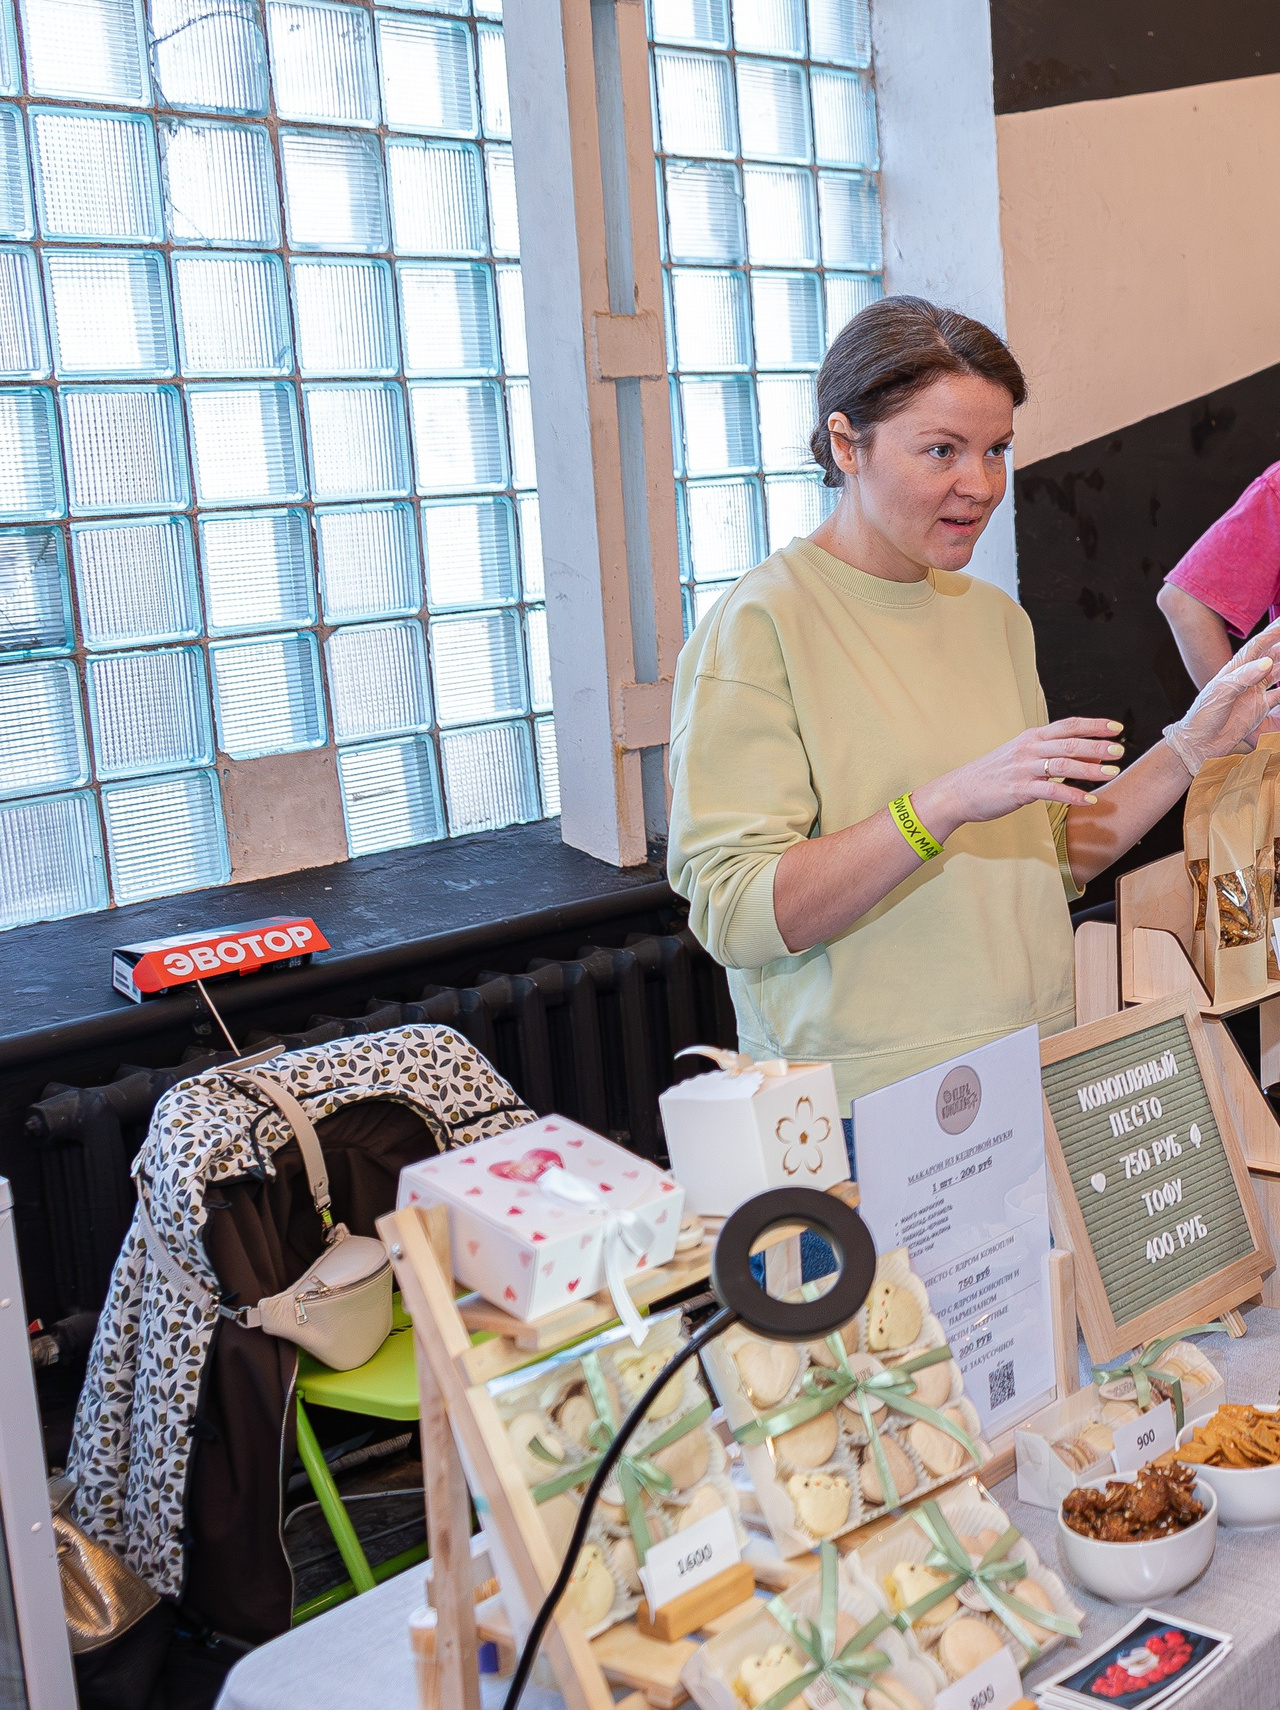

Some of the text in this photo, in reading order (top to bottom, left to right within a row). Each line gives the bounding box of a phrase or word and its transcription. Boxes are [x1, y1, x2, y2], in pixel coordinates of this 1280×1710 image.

[163, 926, 313, 976] ЭВОТОР
[1077, 1049, 1179, 1112] КОНОПЛЯНЫЙ
[1108, 1096, 1163, 1138] ПЕСТО
[945, 1157, 955, 1168] ИЗ
[955, 1137, 992, 1164] КЕДРОВОЙ
[992, 1128, 1014, 1146] МУКИ
[1119, 1134, 1183, 1180] 750 РУБ
[960, 1164, 976, 1180] 200
[978, 1155, 993, 1174] руб
[1141, 1178, 1183, 1217] ТОФУ
[980, 1235, 1014, 1260] КОНОПЛИ
[1145, 1214, 1208, 1264] 400 РУБ
[958, 1265, 991, 1291] 750 руб
[948, 1293, 998, 1327] ПАРМЕЗАНОМ
[1136, 1428, 1156, 1451] 900
[677, 1543, 713, 1577] 1600
[969, 1682, 995, 1710] 800
